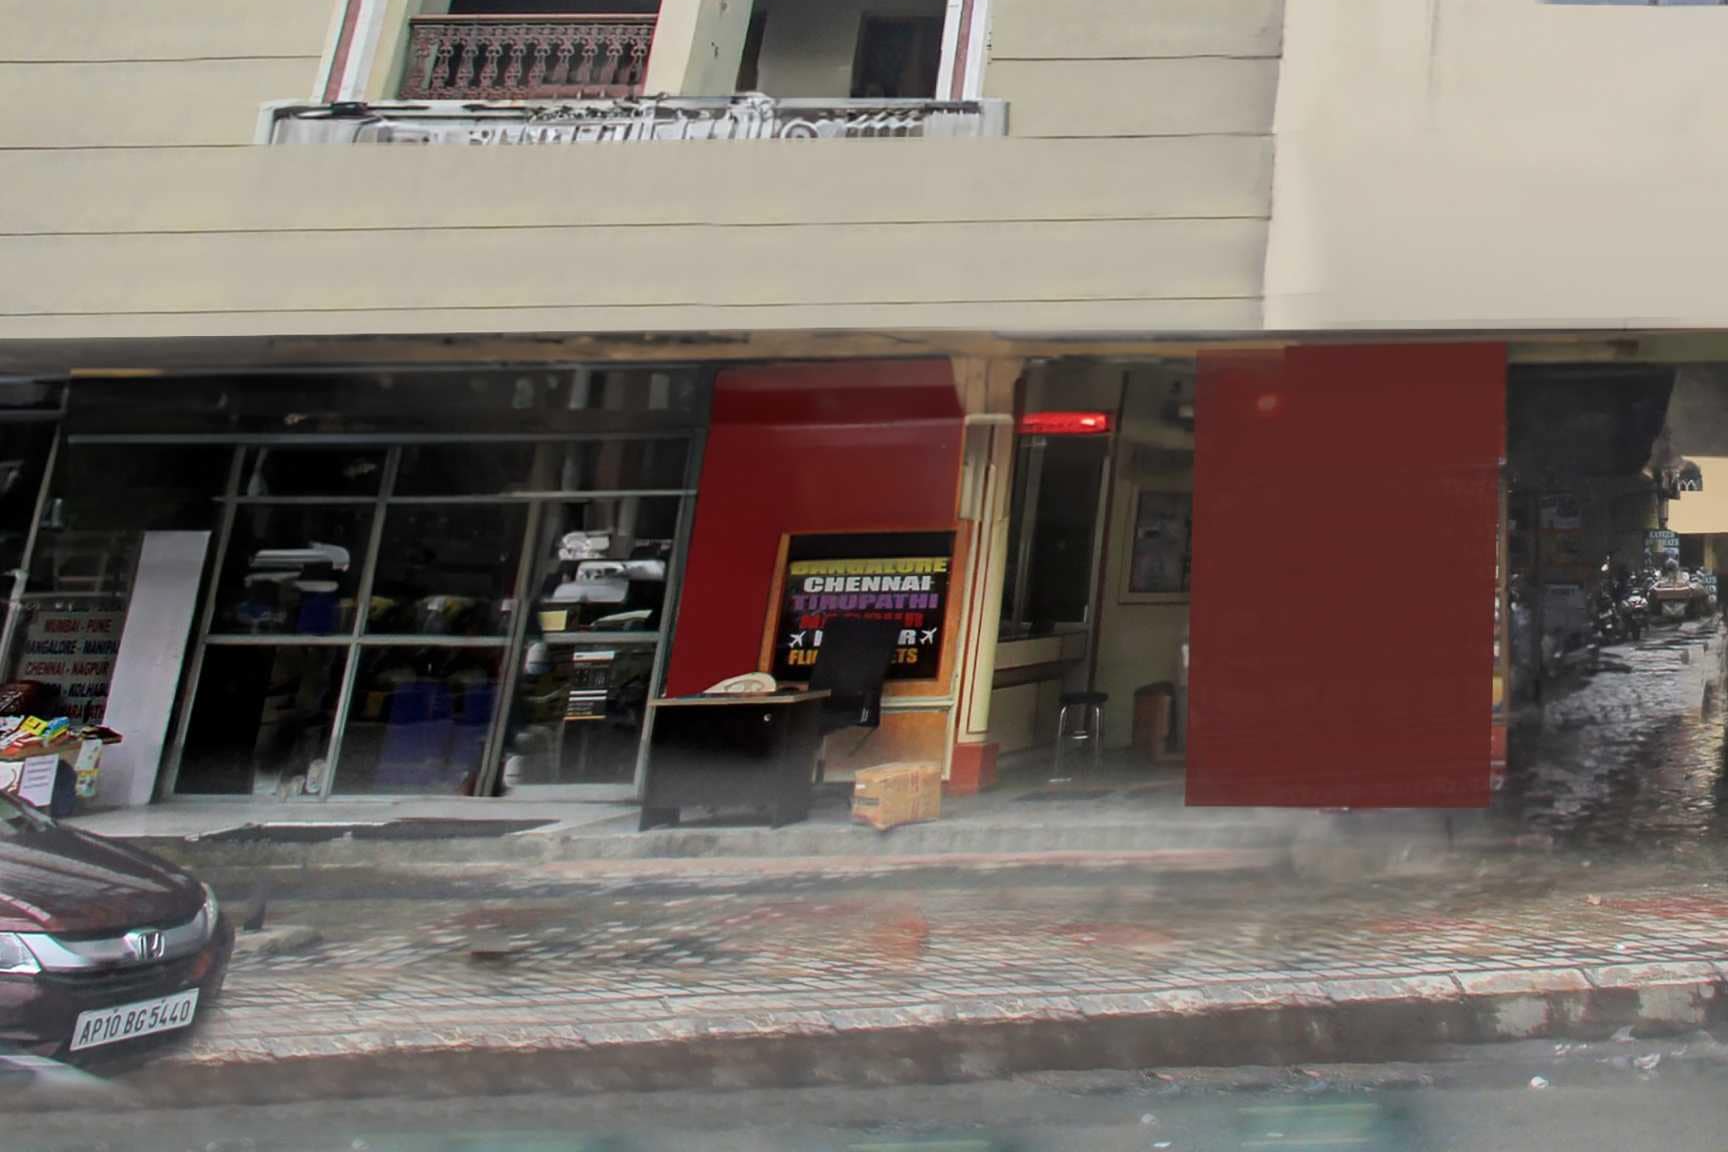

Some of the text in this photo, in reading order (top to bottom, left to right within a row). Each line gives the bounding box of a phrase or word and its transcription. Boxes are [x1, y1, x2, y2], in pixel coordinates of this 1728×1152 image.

[803, 575, 932, 593] CHENNAI
[793, 593, 939, 610] TIRUPATHI
[148, 999, 191, 1028] 5440
